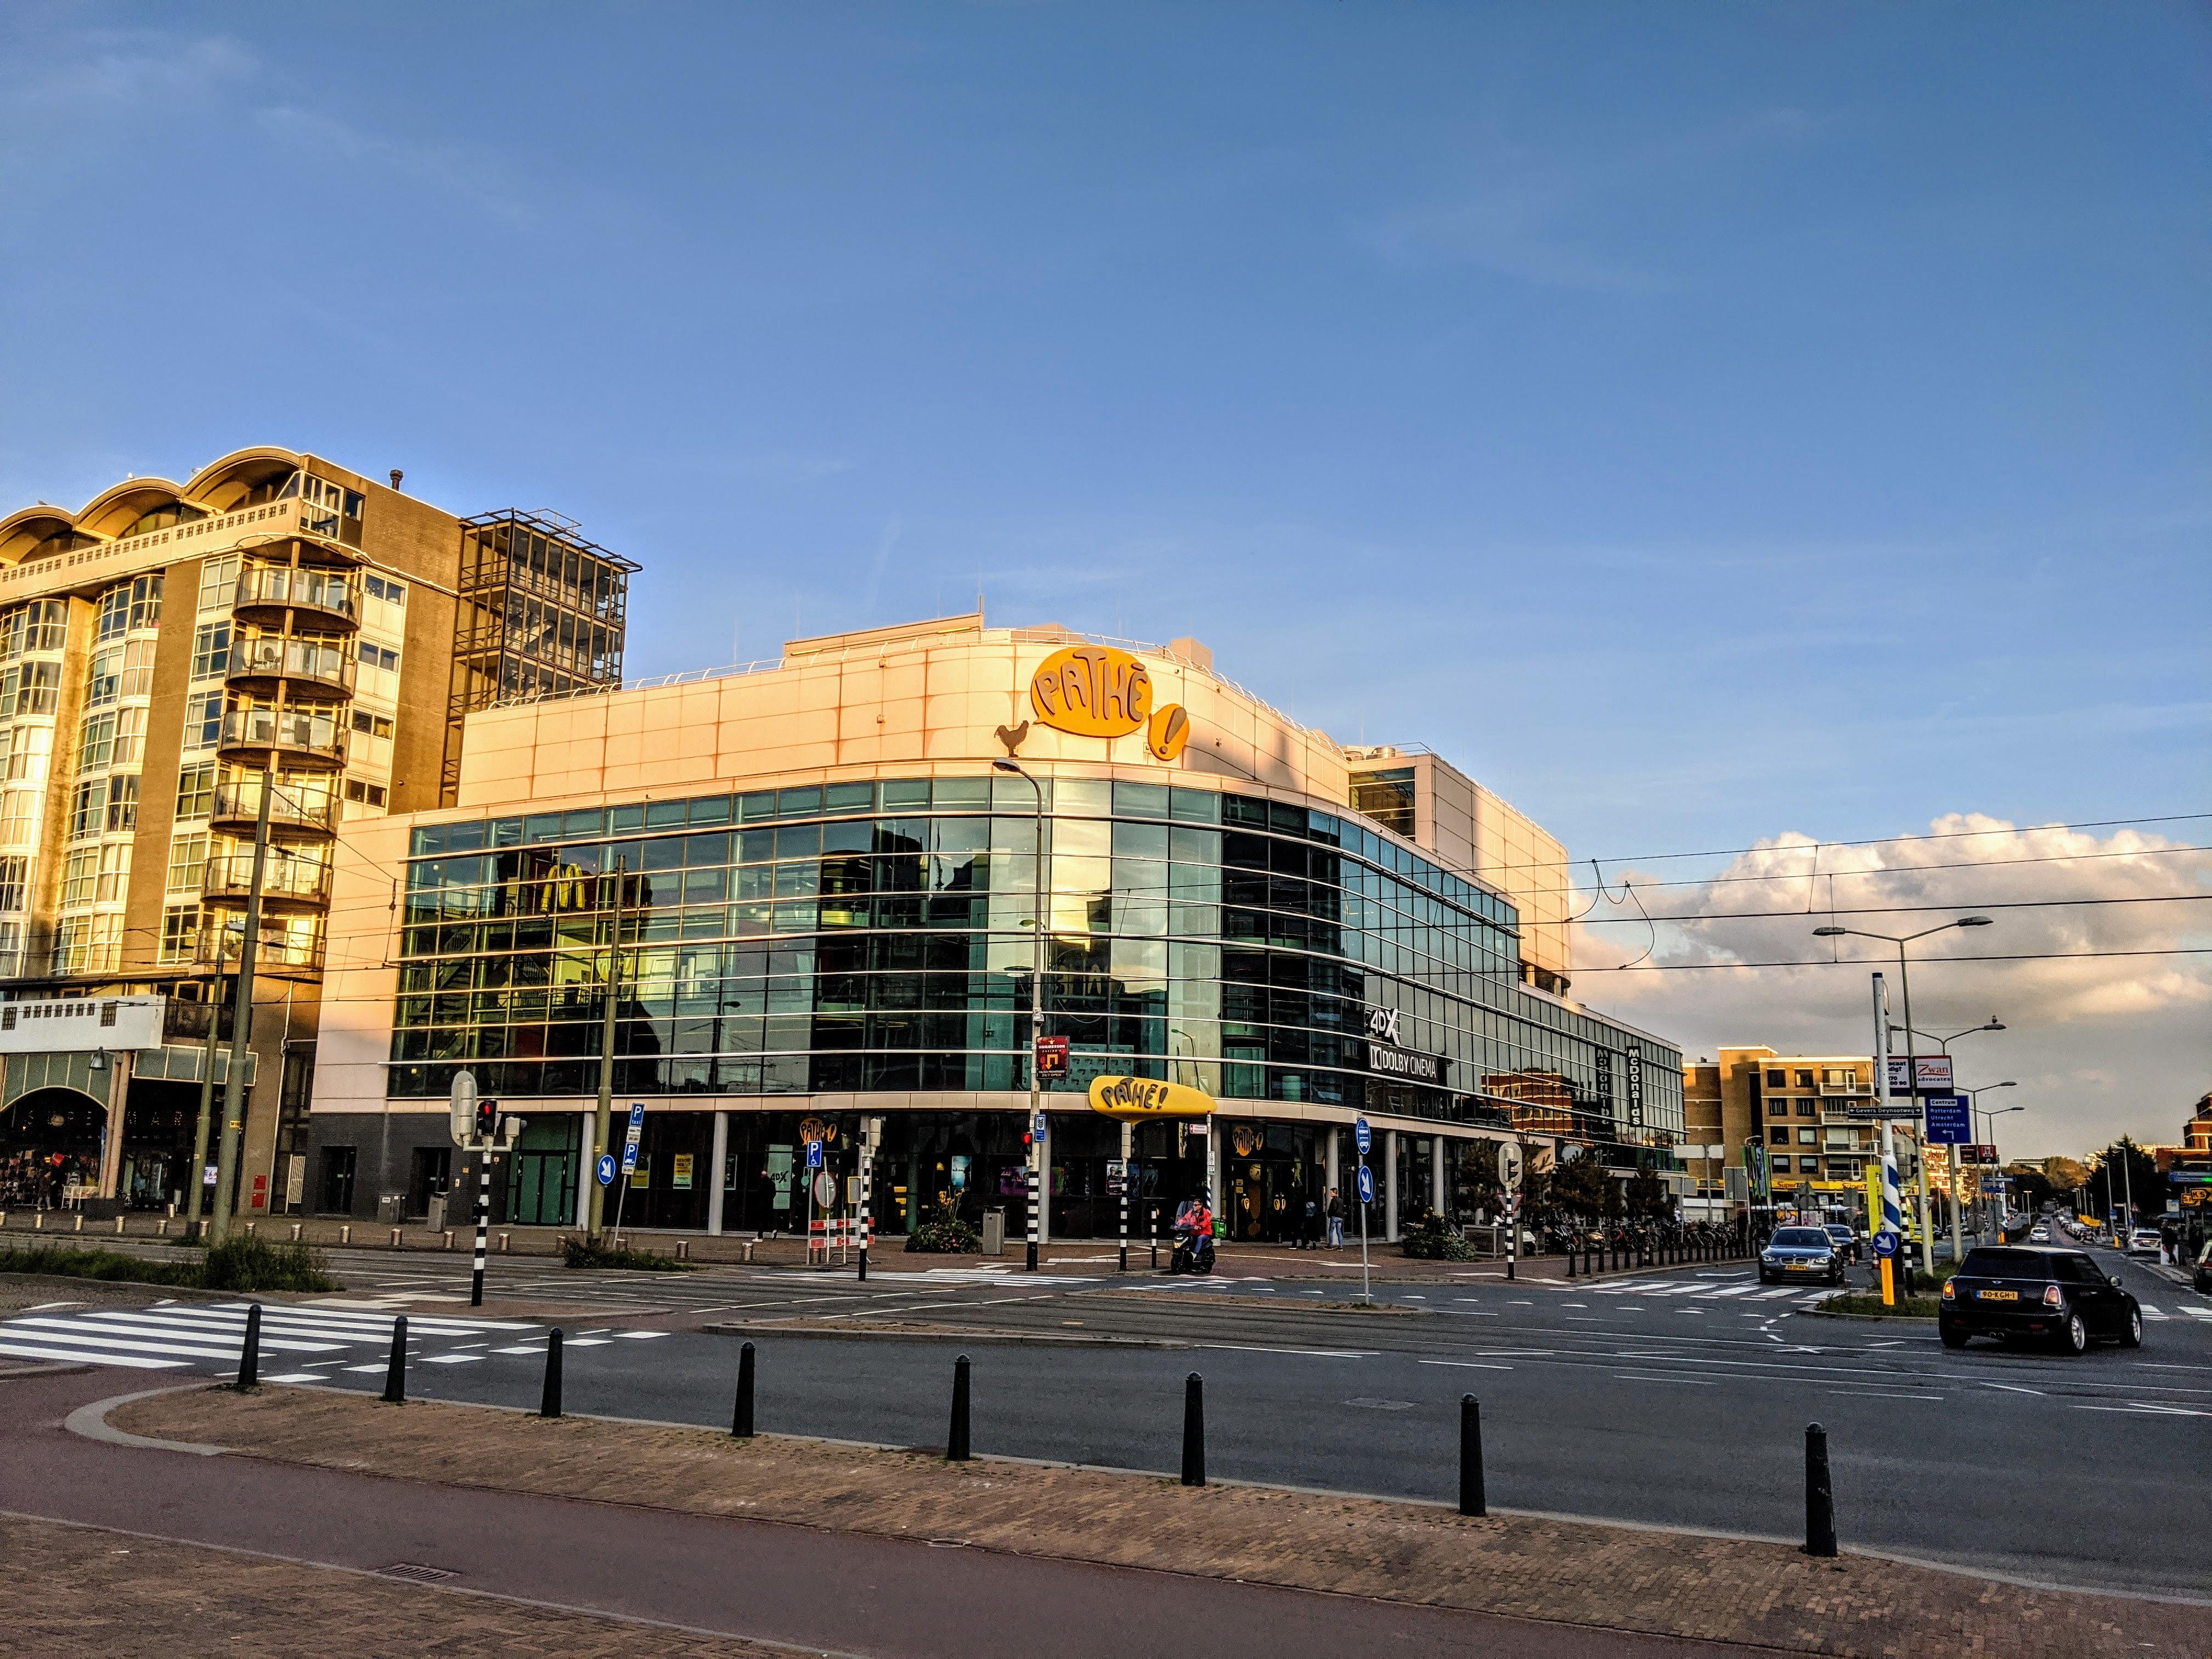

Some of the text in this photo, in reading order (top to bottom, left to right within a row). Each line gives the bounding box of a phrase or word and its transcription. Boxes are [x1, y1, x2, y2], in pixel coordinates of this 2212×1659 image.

[1370, 1008, 1401, 1045] 4DX
[1383, 1050, 1436, 1079] DOLBY CINEMA
[1917, 1064, 1950, 1075] Zwan
[1628, 1049, 1640, 1125] McDonalds
[634, 1105, 641, 1117] P
[627, 1144, 635, 1156] P
[811, 1142, 819, 1156] P
